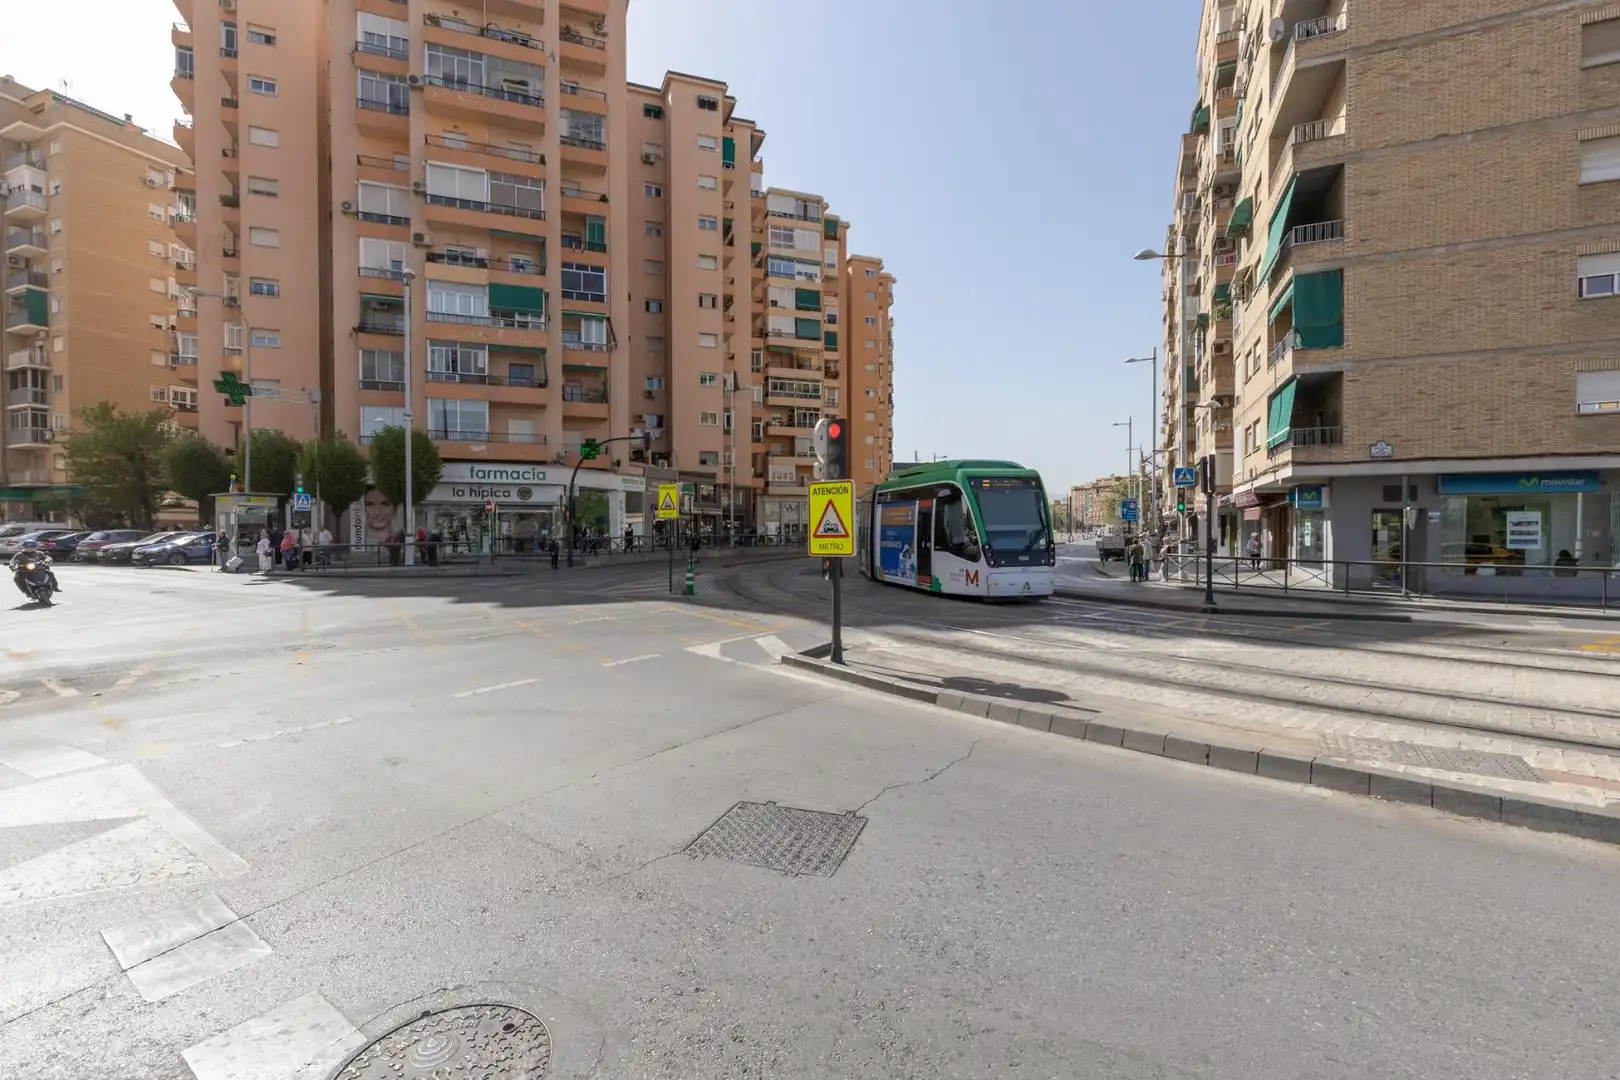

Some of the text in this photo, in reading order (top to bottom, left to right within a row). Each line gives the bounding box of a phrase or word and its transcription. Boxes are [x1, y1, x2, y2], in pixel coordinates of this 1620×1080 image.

[469, 465, 546, 480] farmacia
[1541, 478, 1585, 486] movistar
[452, 487, 465, 497] la
[812, 485, 849, 495] ATENCIÓN
[819, 542, 843, 550] METRO
